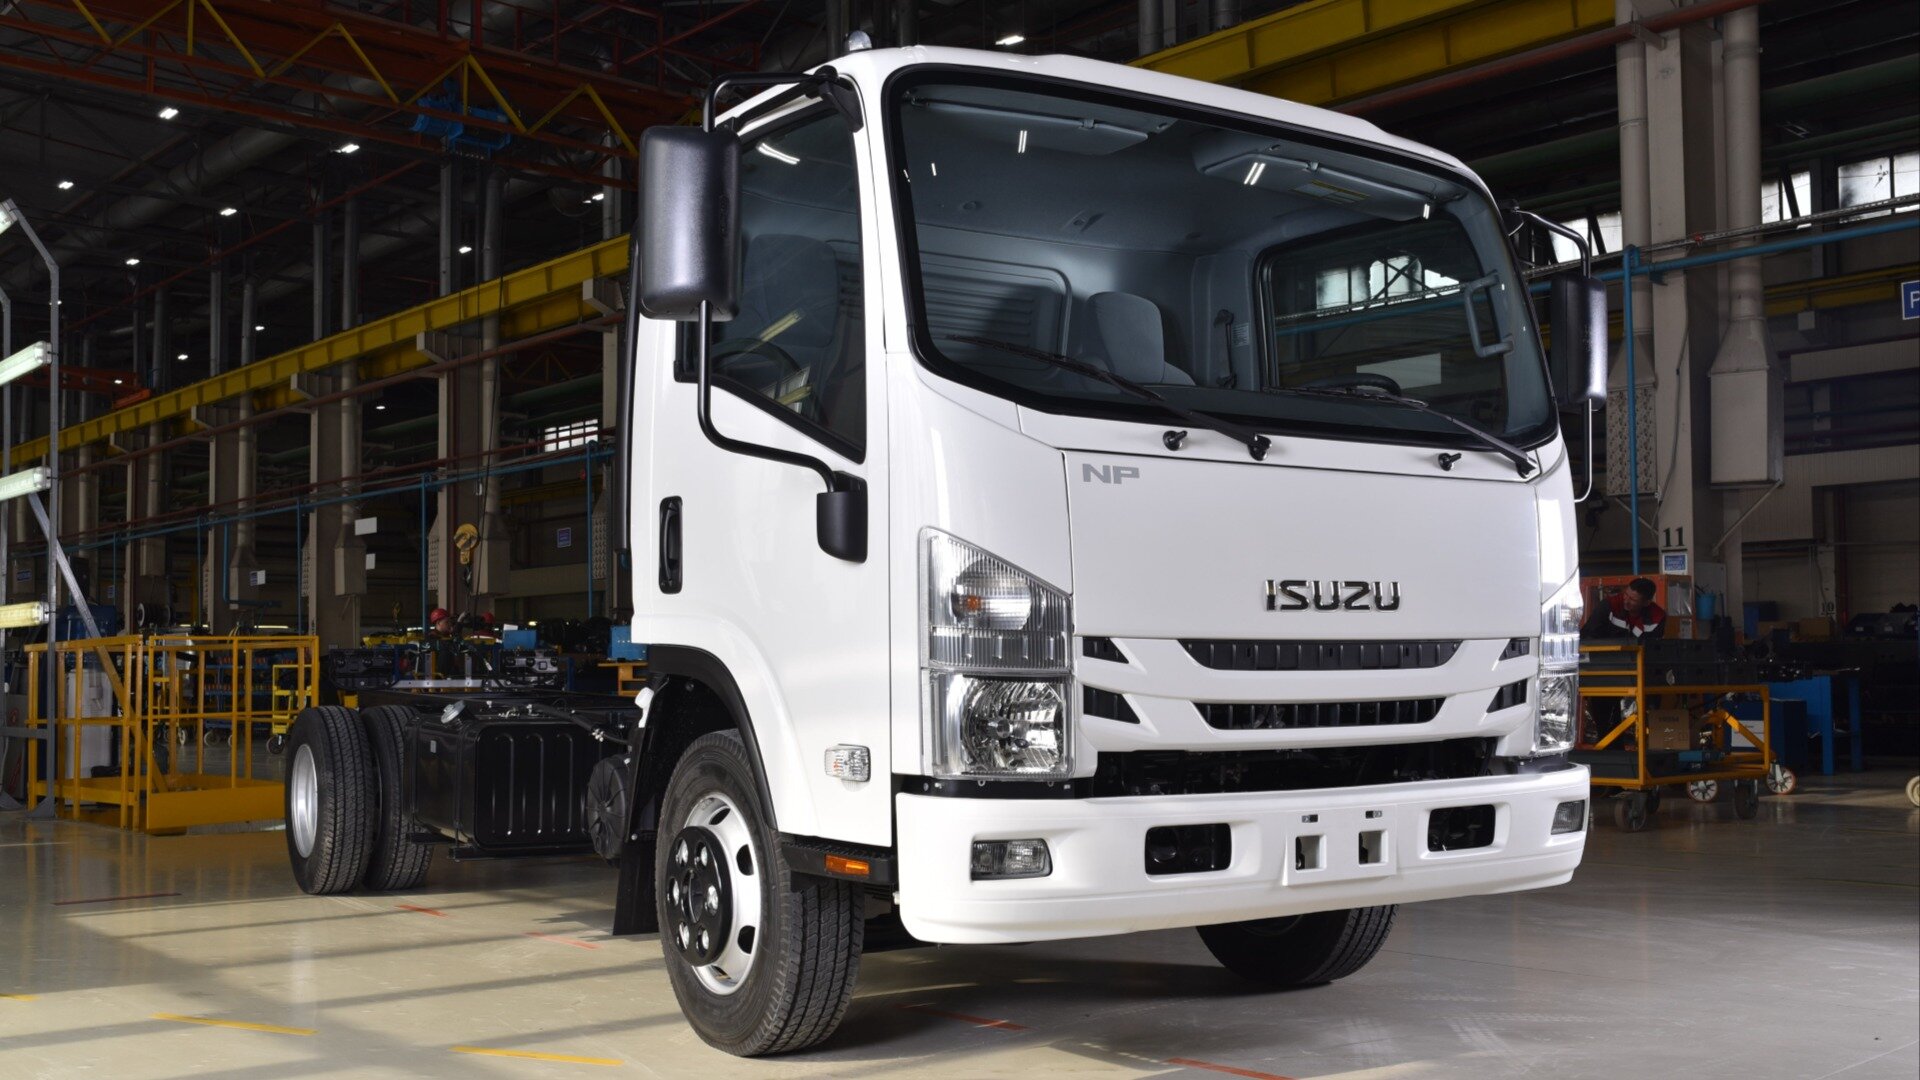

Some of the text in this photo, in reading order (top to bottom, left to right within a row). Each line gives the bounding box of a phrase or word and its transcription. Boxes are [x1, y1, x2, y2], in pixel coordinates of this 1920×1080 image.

[1082, 463, 1140, 485] NP
[1663, 526, 1685, 548] 11
[1265, 579, 1401, 612] ISUZU
